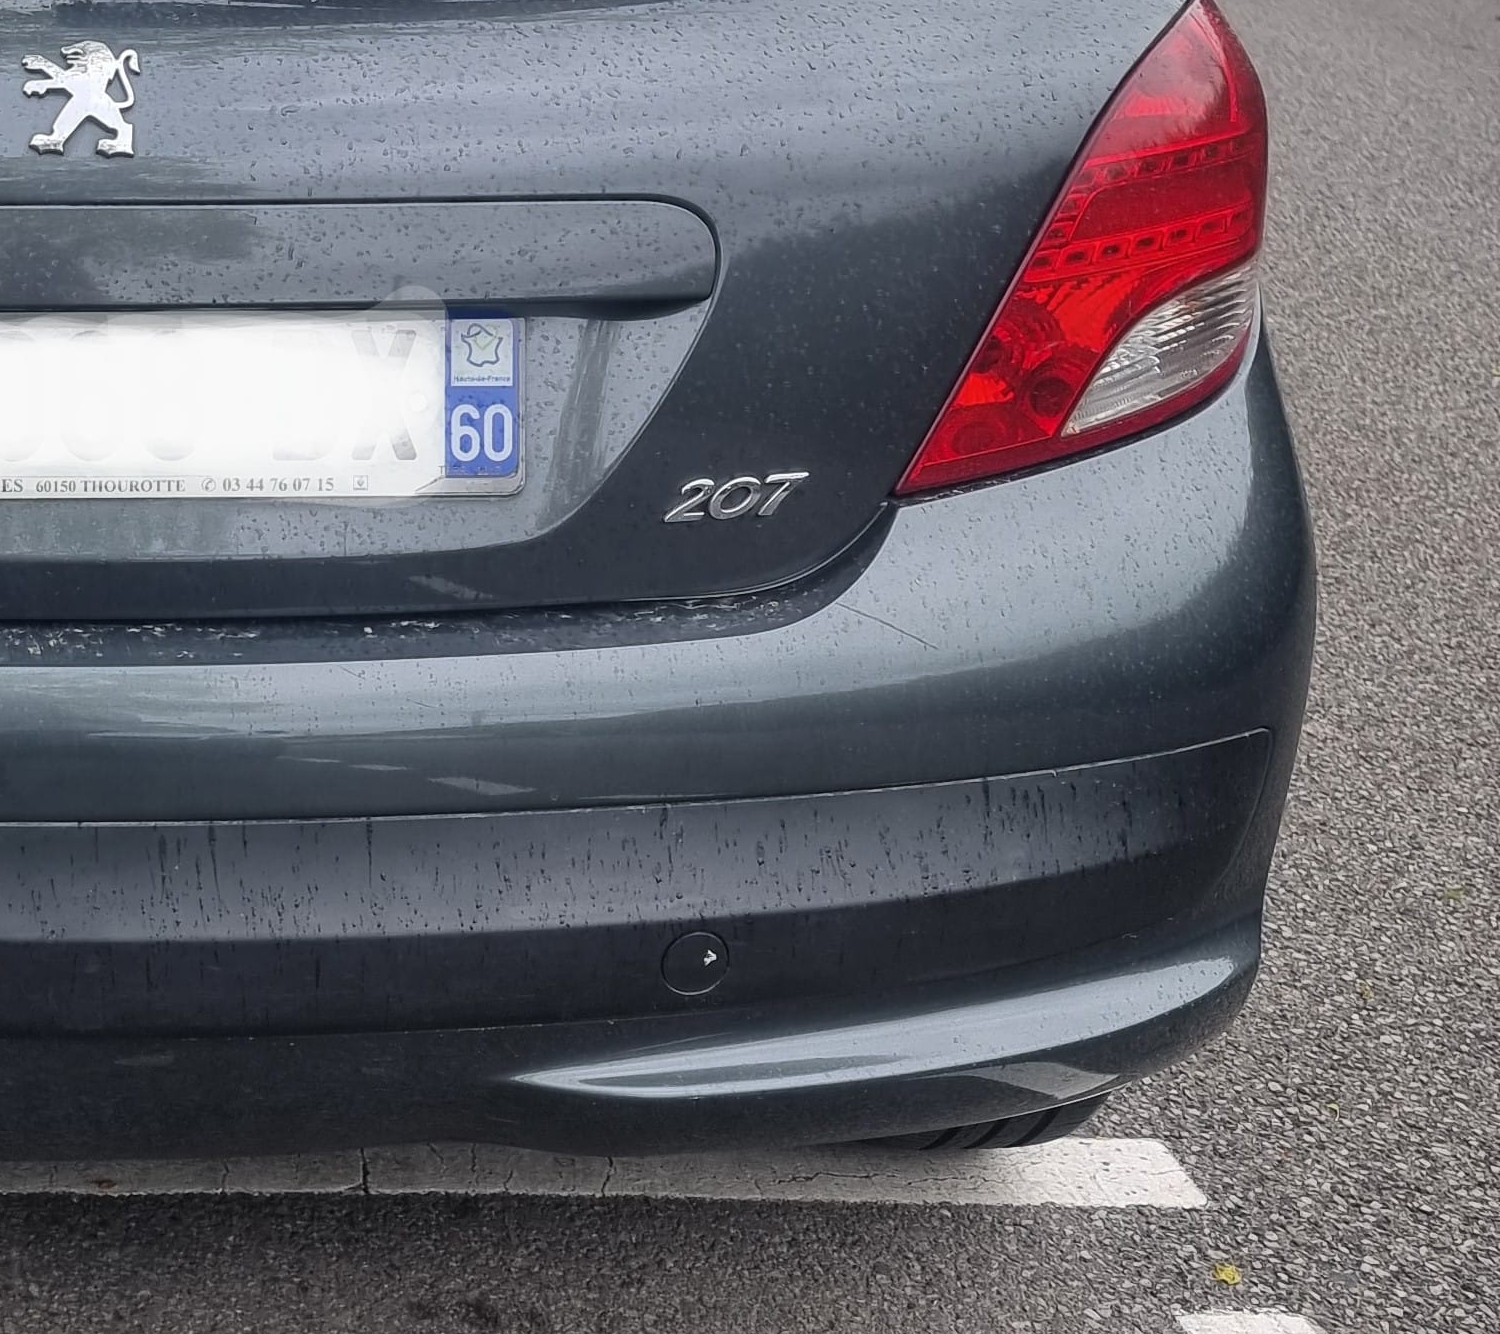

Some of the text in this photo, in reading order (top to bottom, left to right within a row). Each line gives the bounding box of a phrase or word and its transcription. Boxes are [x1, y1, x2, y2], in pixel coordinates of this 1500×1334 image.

[451, 404, 513, 461] 60
[36, 480, 77, 493] 60150
[80, 479, 186, 493] THOUROTTE
[222, 477, 241, 492] 03
[246, 477, 264, 492] 44
[269, 477, 288, 492] 76
[292, 477, 311, 492] 07
[317, 477, 335, 492] 15
[664, 471, 810, 523] 207
